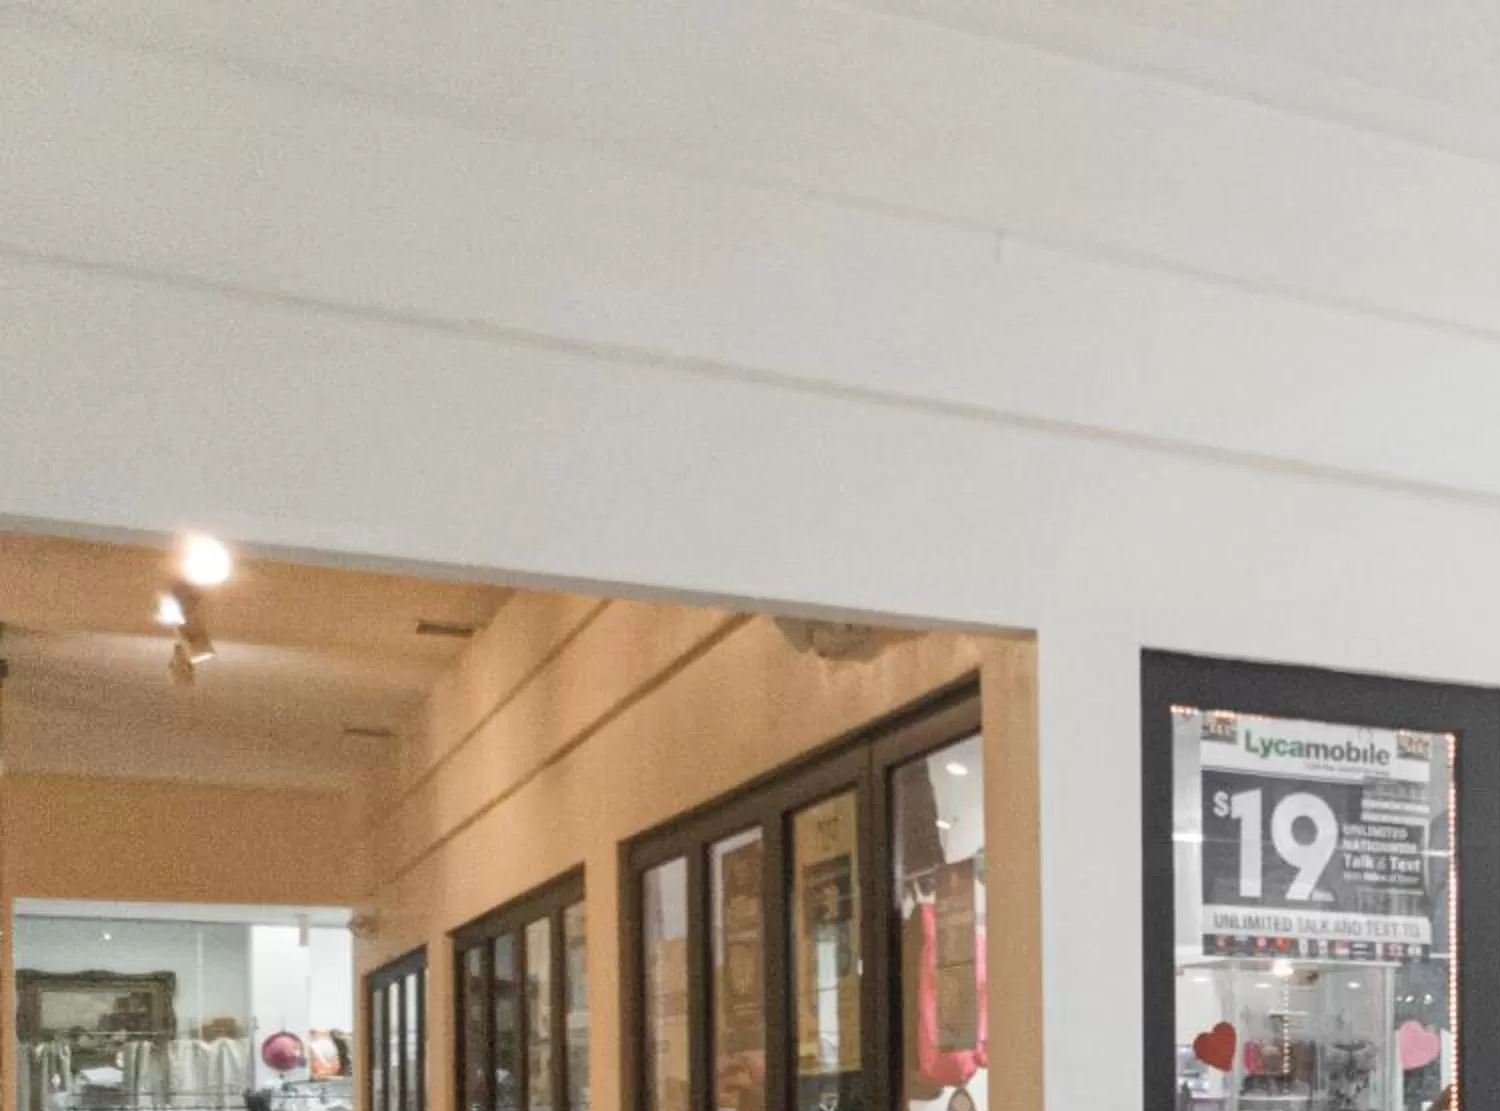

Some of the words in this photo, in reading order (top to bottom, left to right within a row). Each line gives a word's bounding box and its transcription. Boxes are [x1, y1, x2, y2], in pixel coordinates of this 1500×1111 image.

[1244, 729, 1391, 766] Lycamobile
[1343, 853, 1374, 869] Talk
[1213, 912, 1293, 932] UNLIMITED
[1297, 917, 1329, 934] TALK
[1331, 919, 1361, 936] AND
